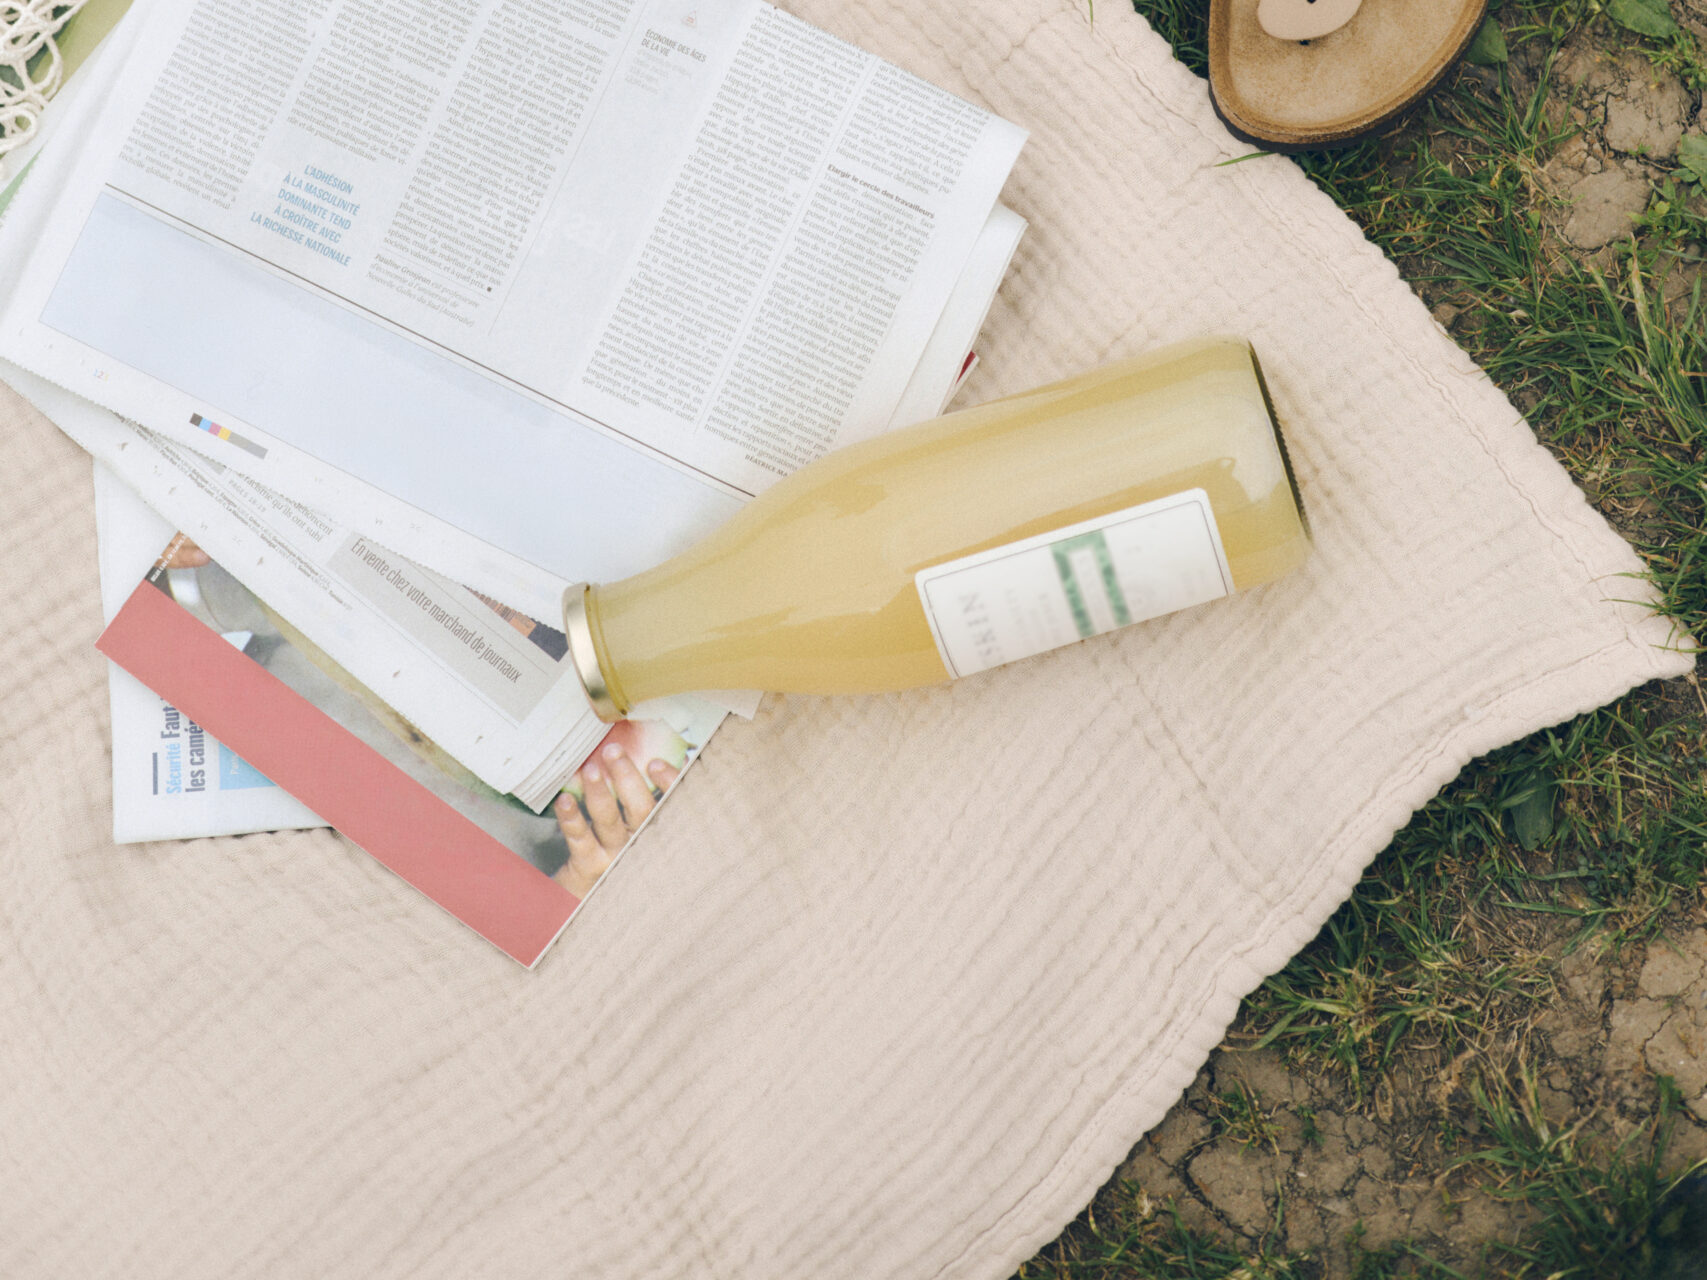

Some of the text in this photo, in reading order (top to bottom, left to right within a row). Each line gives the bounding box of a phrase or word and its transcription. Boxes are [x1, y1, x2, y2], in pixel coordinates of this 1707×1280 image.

[641, 38, 669, 56] DE LA VIE
[645, 28, 706, 62] ÉCONOMIE DES ÂGES
[278, 189, 351, 229] DOMINANTE TEND
[282, 171, 359, 215] À LA MASCULINITÉ
[827, 164, 850, 178] Elargir
[859, 180, 880, 192] cercle
[881, 190, 893, 199] des
[894, 195, 933, 218] travailleurs
[250, 211, 350, 265] LA RICHESSE NATIONALE
[273, 202, 341, 243] À CROÎTRE AVEC
[774, 467, 789, 479] MA
[243, 476, 323, 542] racisme qu'ils ont subi
[351, 537, 365, 556] En
[362, 550, 389, 575] vente
[385, 569, 409, 592] chez
[406, 585, 432, 610] votre
[428, 604, 476, 644] marchand
[470, 636, 485, 653] de
[478, 644, 521, 682] journaux
[159, 702, 183, 793] Sécurité Faut
[182, 719, 207, 792] les camé
